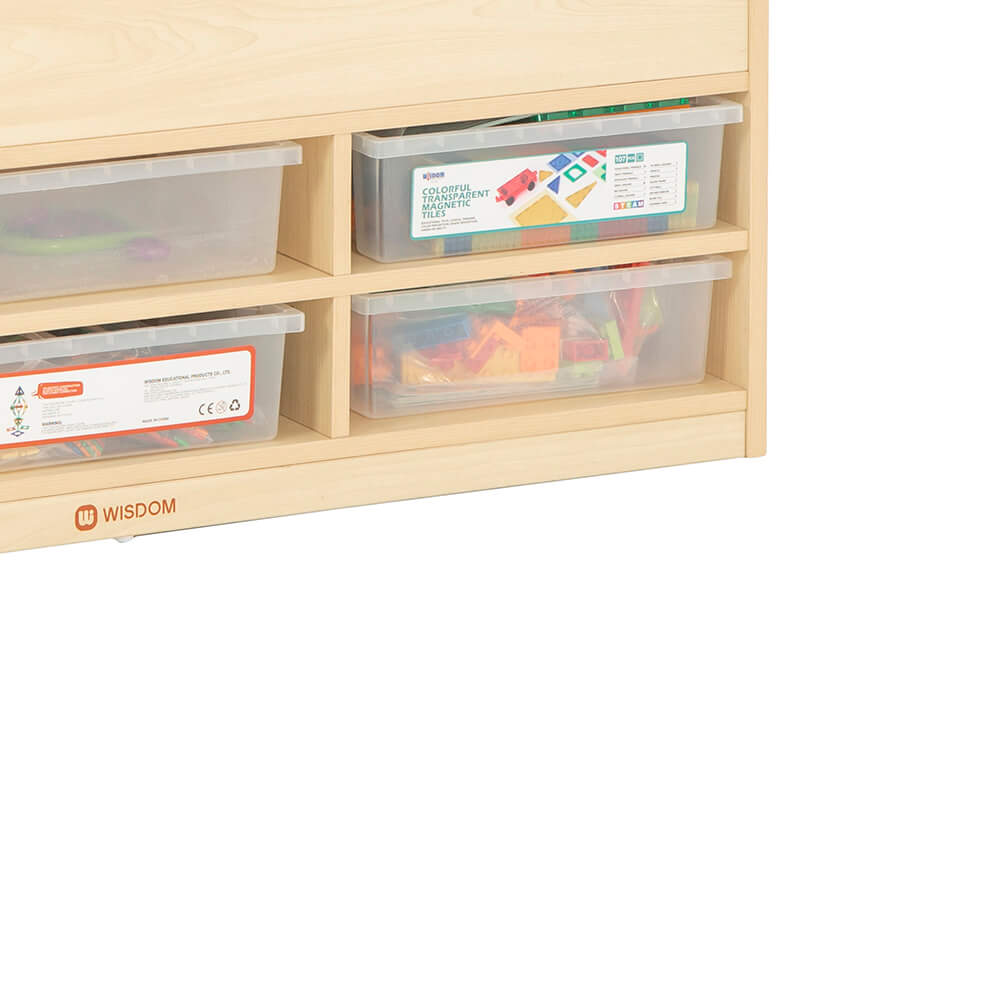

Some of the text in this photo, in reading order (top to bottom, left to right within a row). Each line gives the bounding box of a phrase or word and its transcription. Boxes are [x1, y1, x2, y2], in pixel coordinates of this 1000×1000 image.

[422, 184, 471, 195] COLORFUL
[422, 190, 489, 203] TRANSPARENT
[422, 200, 471, 210] MAGNETIC
[613, 200, 644, 210] STEAM
[422, 210, 446, 219] TILES
[103, 497, 176, 523] WISDOM
